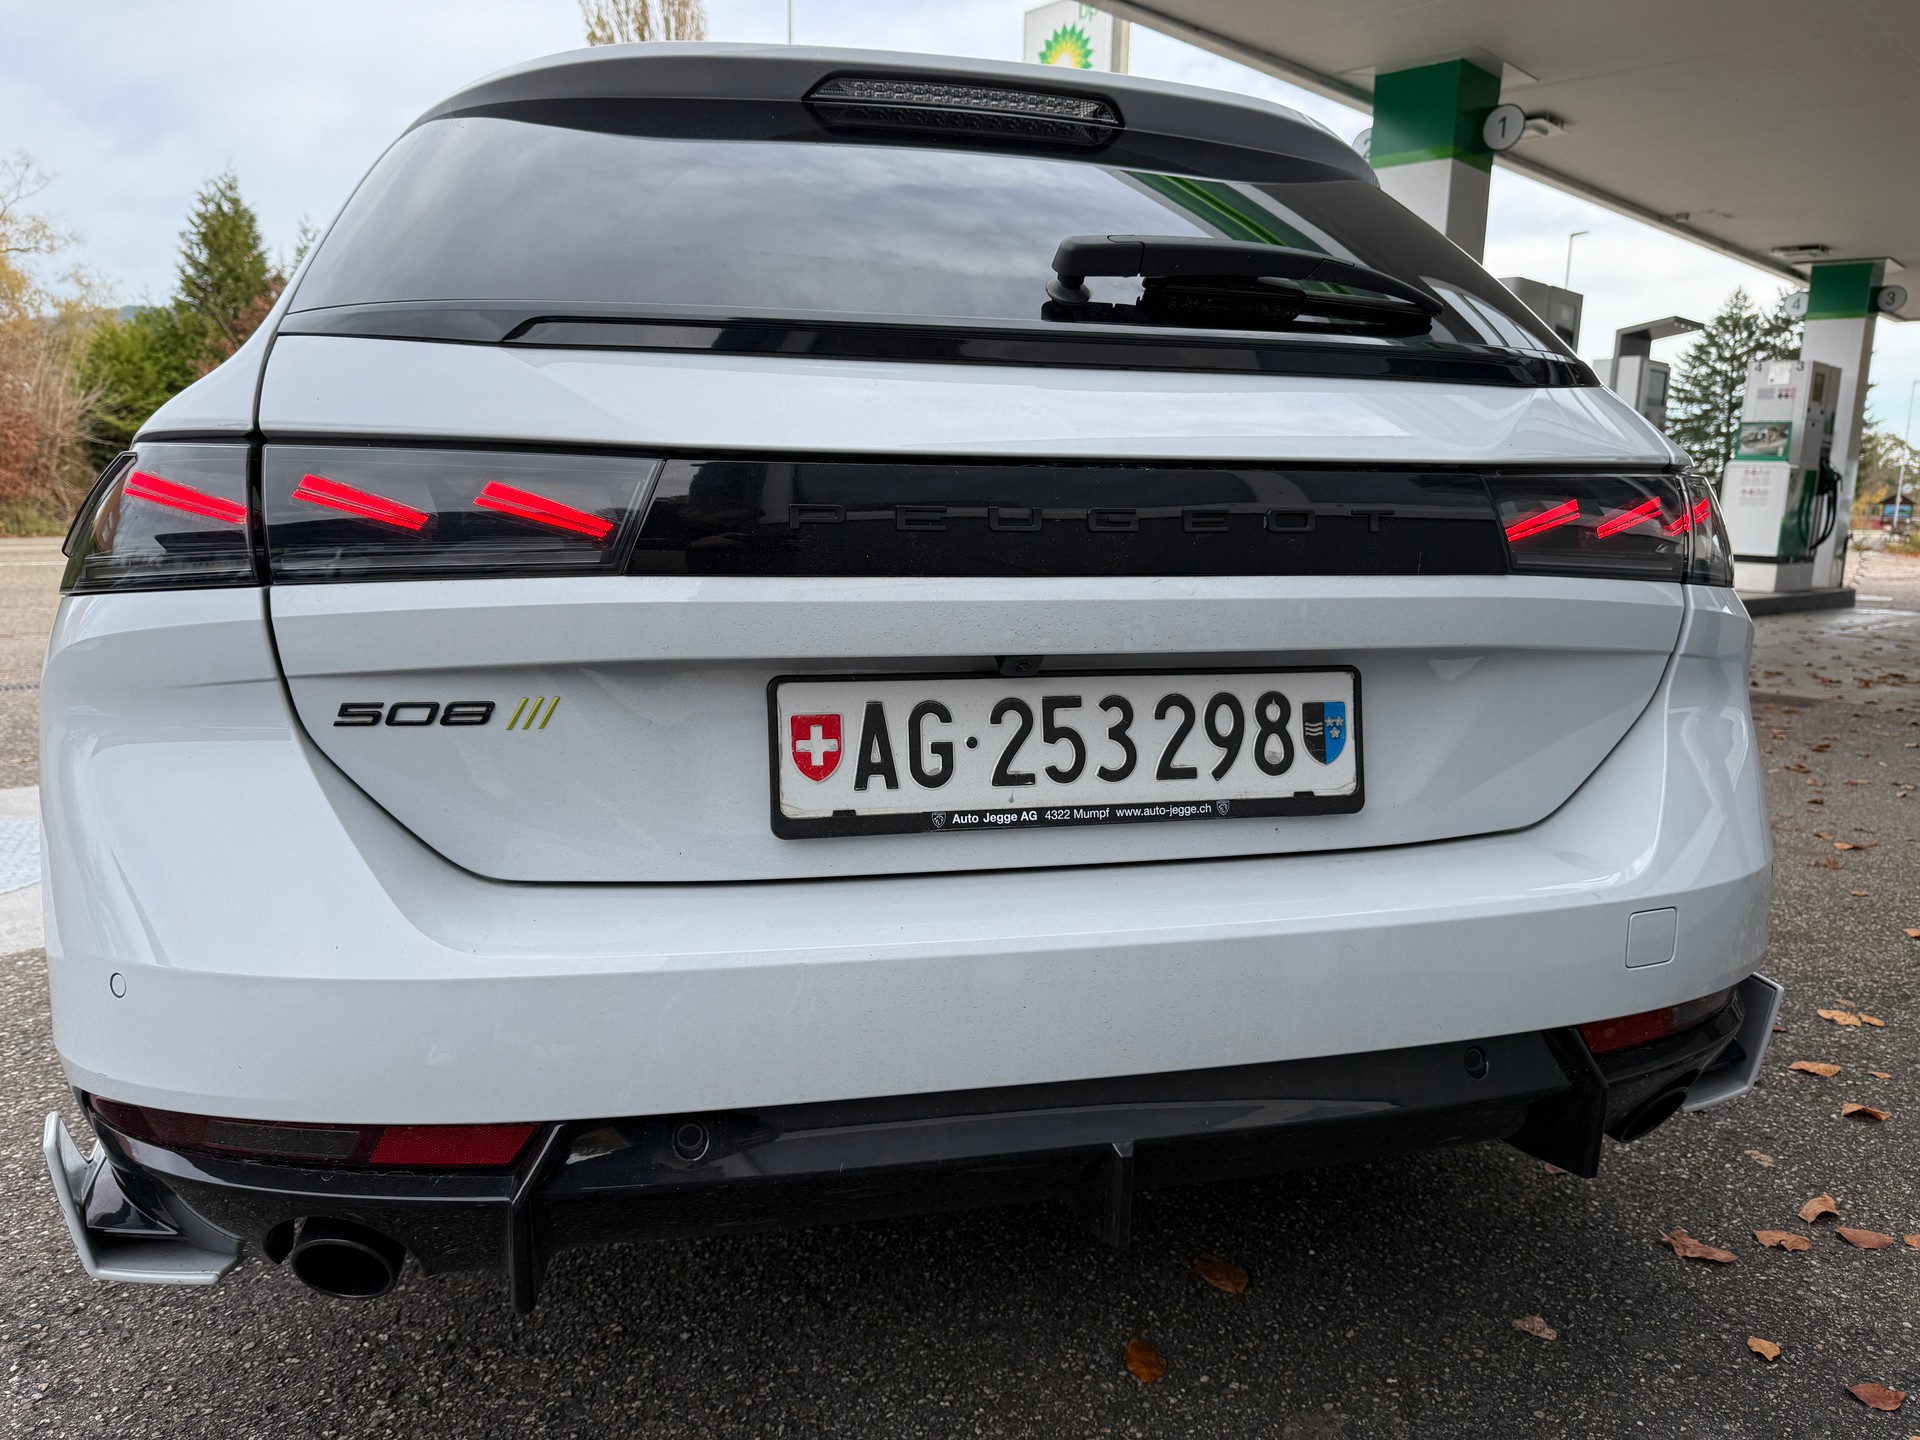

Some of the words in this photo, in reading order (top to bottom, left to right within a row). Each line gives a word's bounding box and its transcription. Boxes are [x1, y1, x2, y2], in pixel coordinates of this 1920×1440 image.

[1498, 116, 1506, 138] 1
[1886, 291, 1896, 306] 3
[788, 503, 1395, 533] PEUGEOT
[333, 700, 496, 727] 508
[952, 813, 980, 824] Auto
[983, 812, 1018, 824] Jegge
[1020, 810, 1038, 821] AG
[1045, 809, 1071, 820] 4322
[1073, 807, 1110, 820] Mumpf
[1115, 803, 1212, 817] www.auto-jegge.ch
